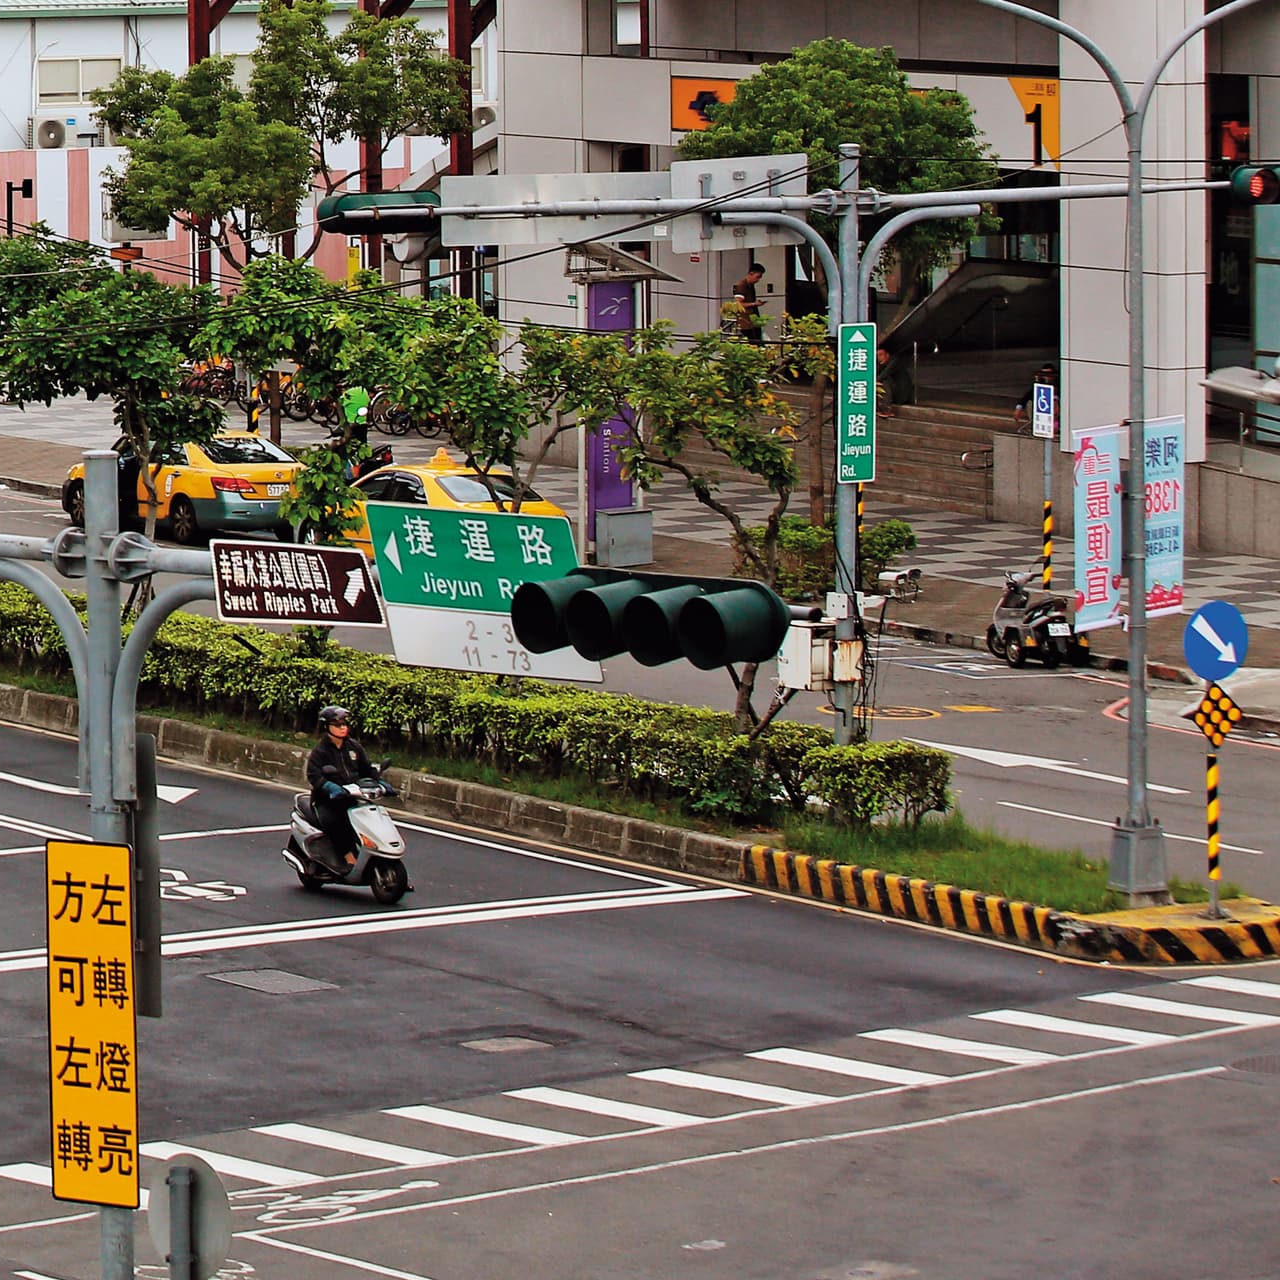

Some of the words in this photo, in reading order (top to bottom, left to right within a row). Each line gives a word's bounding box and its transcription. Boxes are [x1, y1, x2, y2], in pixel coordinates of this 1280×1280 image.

[1025, 103, 1043, 166] 1
[847, 347, 868, 437] 捷運路
[842, 443, 872, 458] Jieyun
[842, 464, 857, 477] Rd.
[402, 514, 553, 566] 捷運路
[223, 590, 259, 612] Sweet
[263, 591, 307, 617] Ripples
[310, 593, 340, 615] Park
[420, 571, 483, 601] Jieyun
[51, 871, 95, 1172] 方可左轉
[90, 873, 134, 1177] 左轉燈亮
